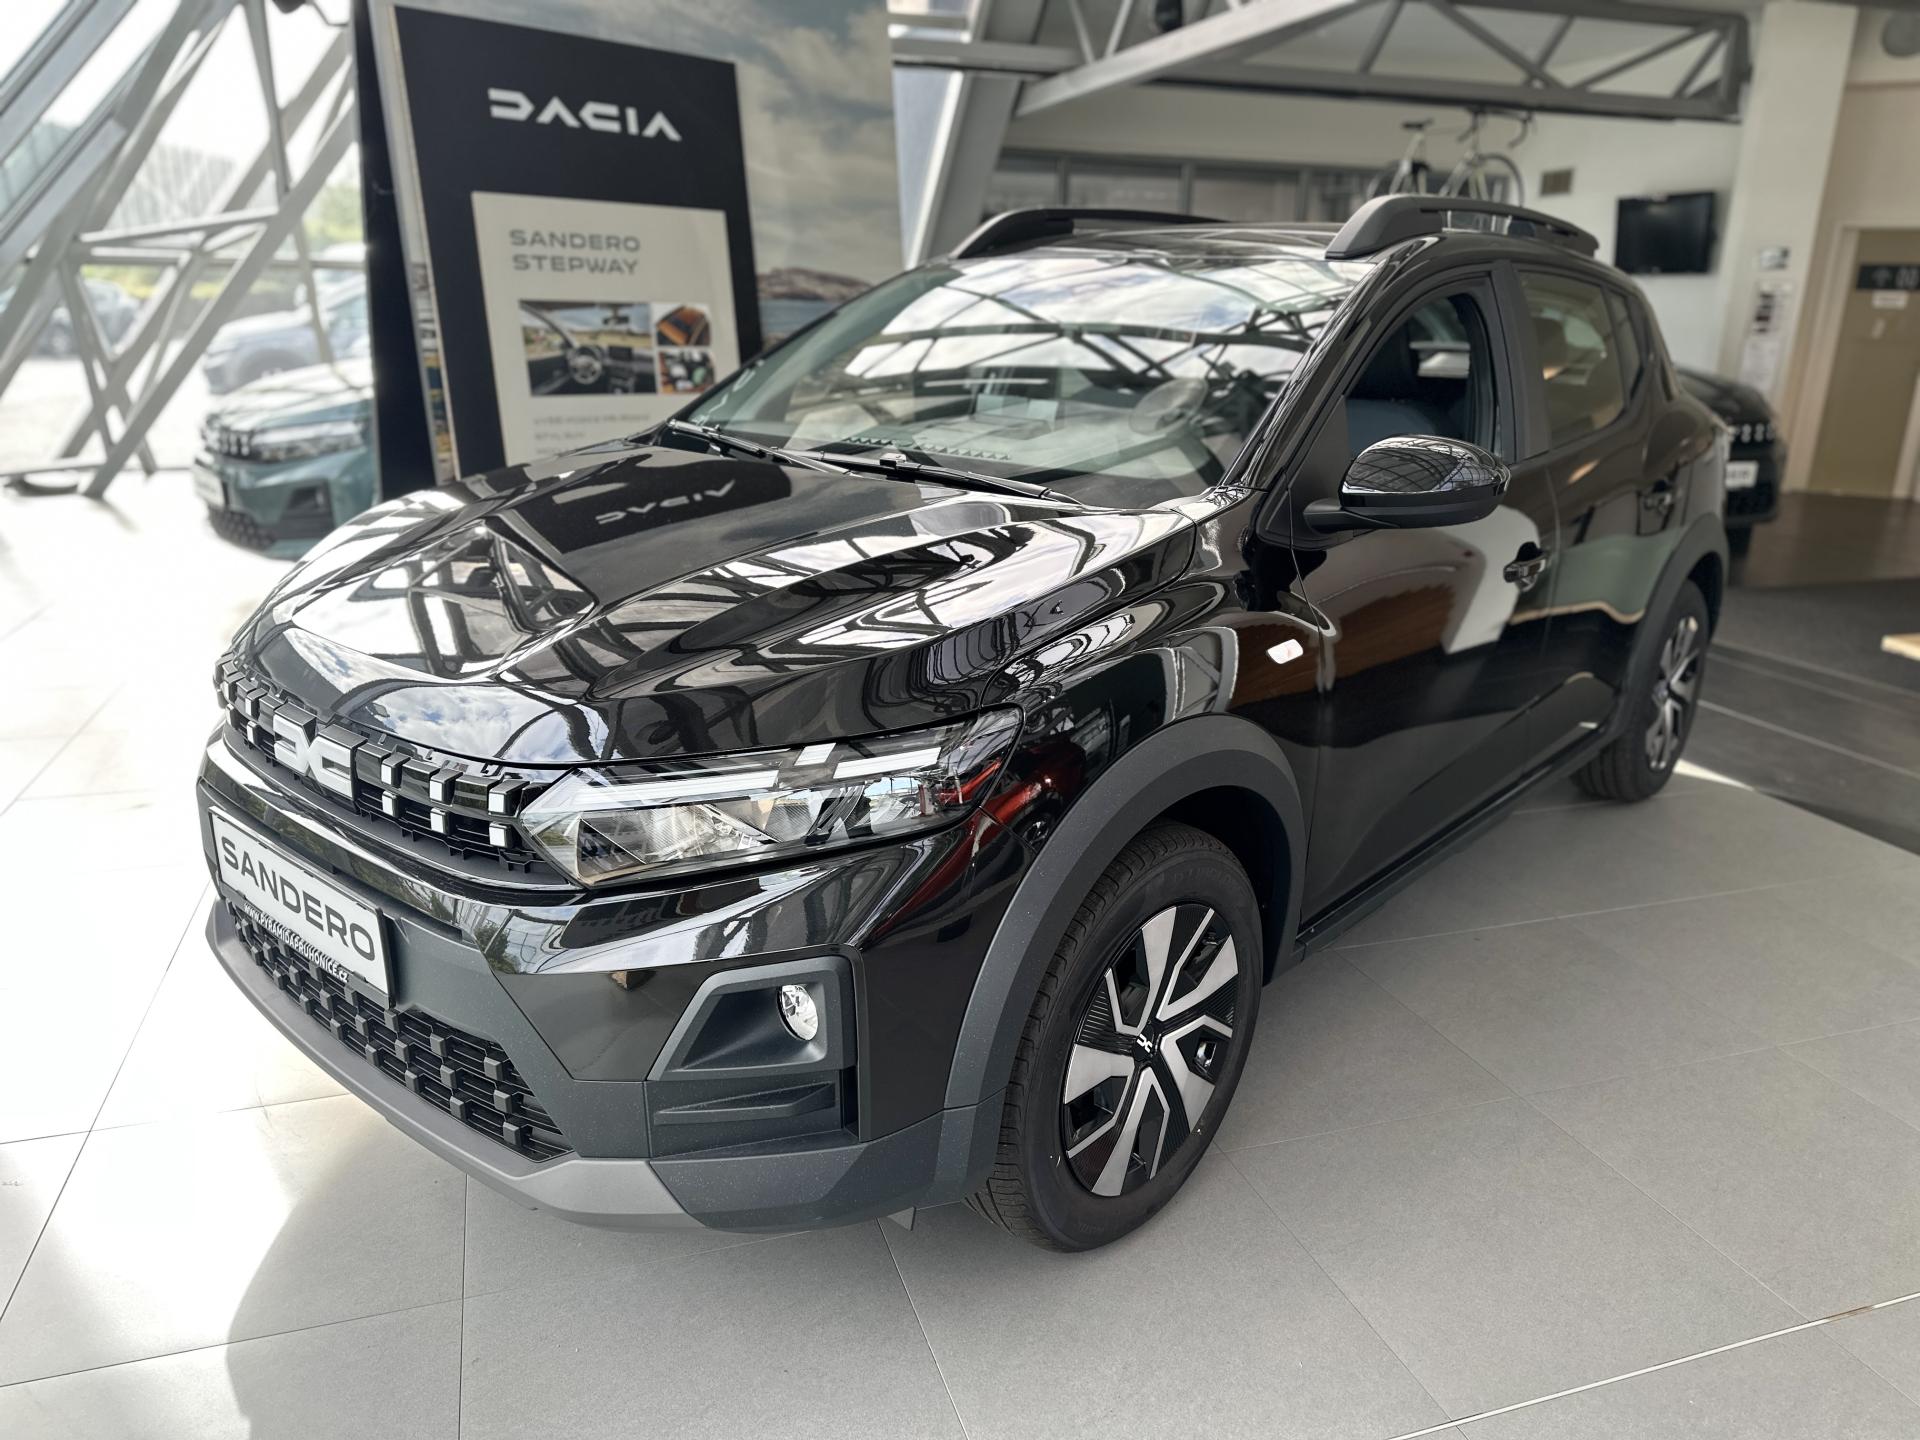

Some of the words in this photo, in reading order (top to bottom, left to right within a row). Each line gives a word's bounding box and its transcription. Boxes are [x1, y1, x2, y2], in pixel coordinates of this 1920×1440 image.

[487, 87, 682, 142] DACIA
[509, 229, 641, 252] SANDERO
[512, 253, 638, 275] STEPWAY
[221, 836, 375, 961] SANDERO
